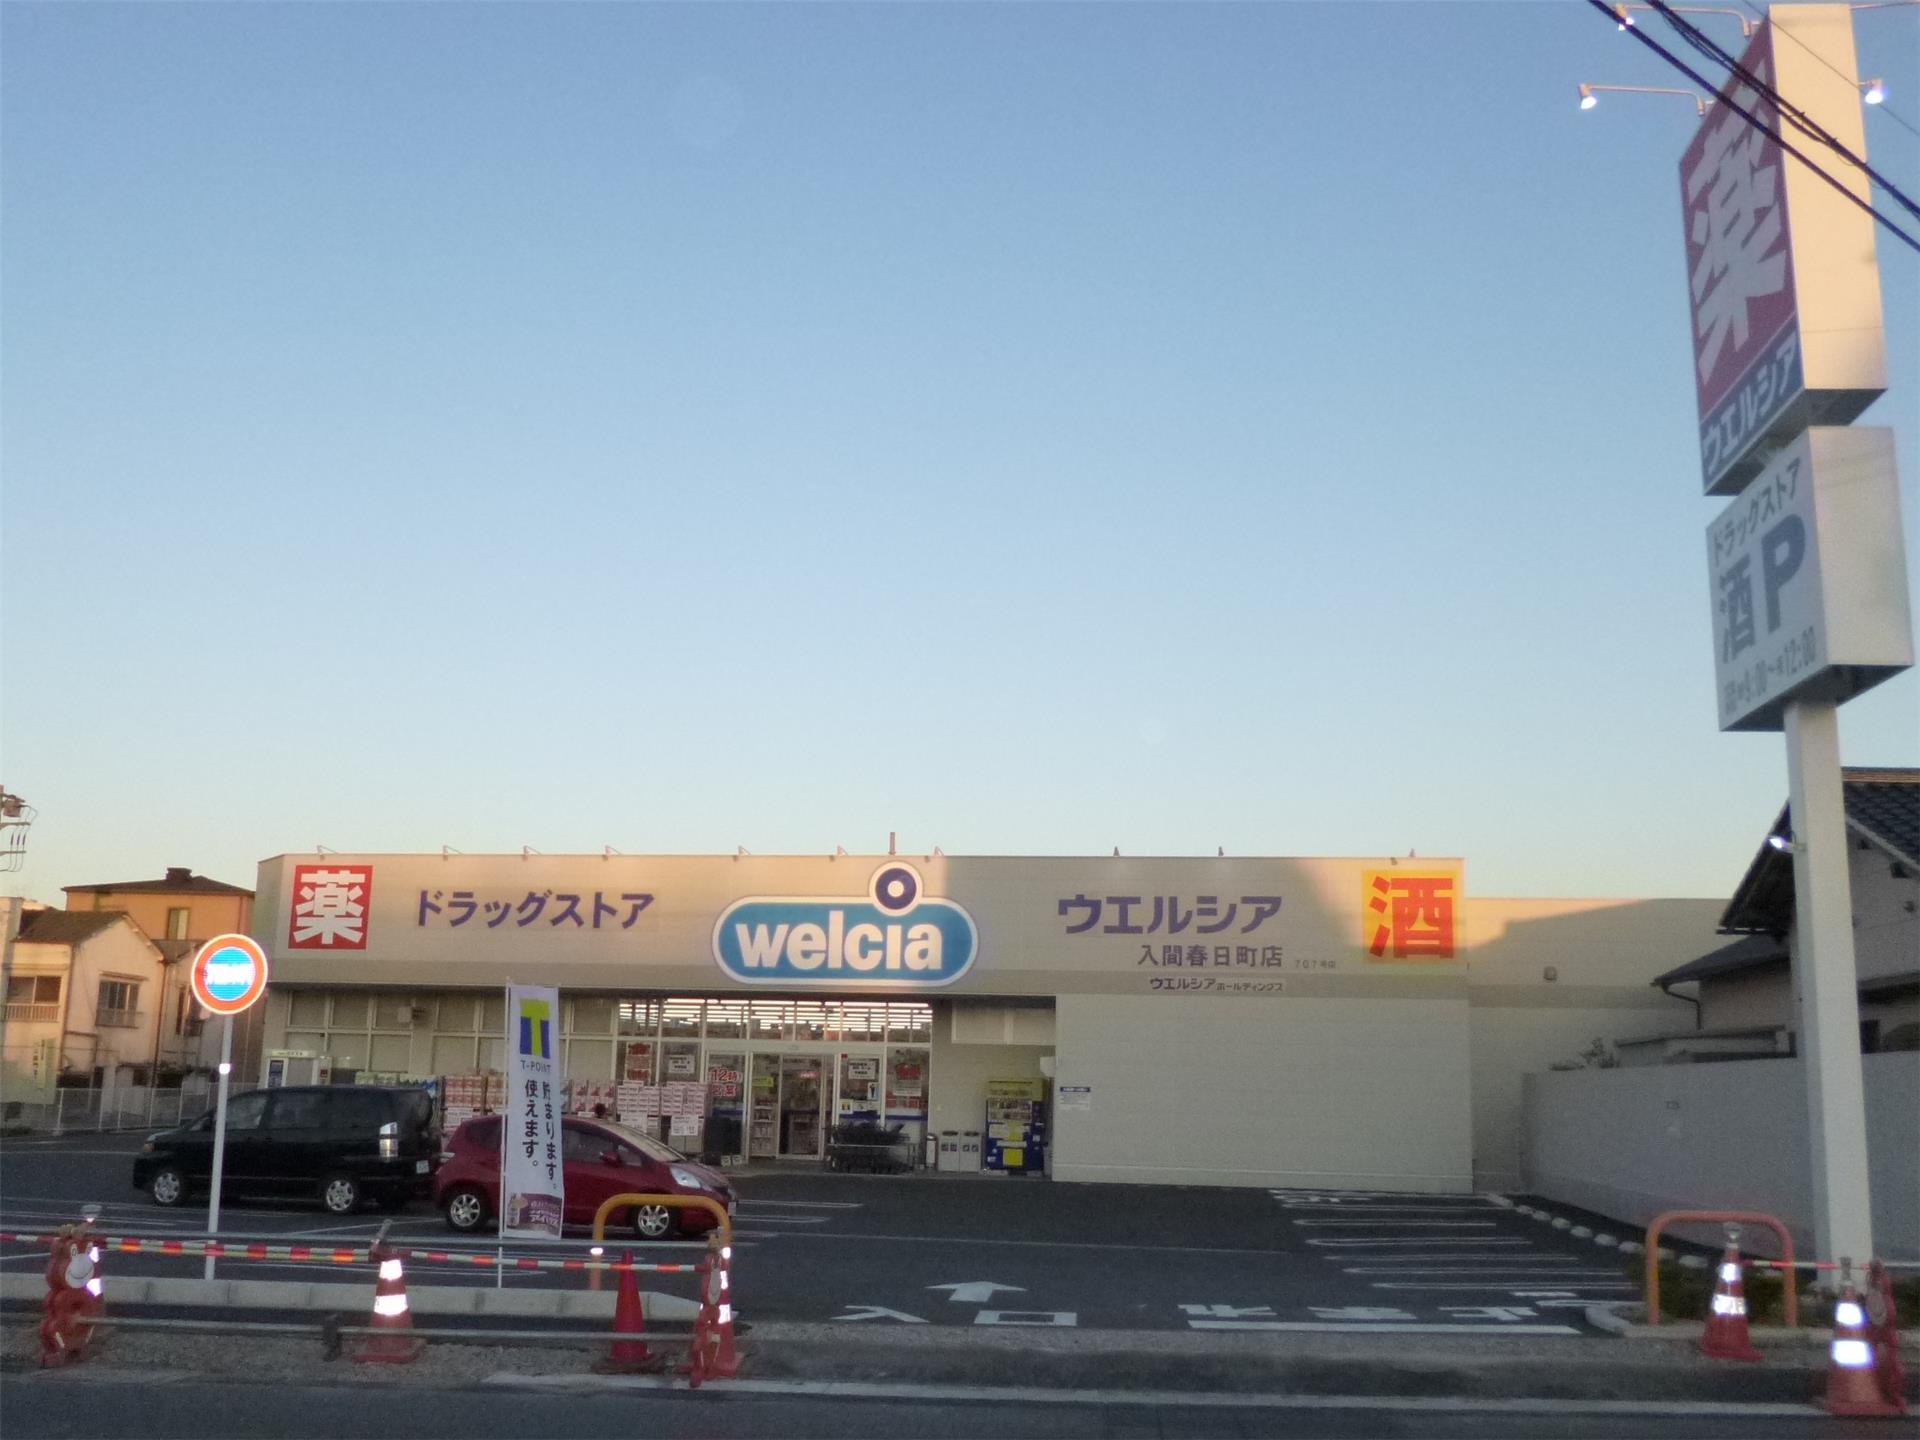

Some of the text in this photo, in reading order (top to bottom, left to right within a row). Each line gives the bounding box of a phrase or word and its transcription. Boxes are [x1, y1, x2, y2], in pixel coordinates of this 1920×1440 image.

[1687, 56, 1787, 384] 薬
[1702, 331, 1797, 475] ウエルシア
[1720, 513, 1806, 664] 酒 P
[293, 870, 366, 944] 薬
[418, 889, 655, 928] ドラッグストア
[735, 910, 943, 970] welcia
[1057, 894, 1282, 934] ウエルシア
[1368, 876, 1454, 958] 酒
[1138, 944, 1283, 968] 入間春日町店
[522, 1079, 539, 1168] 使えます。
[831, 1305, 1077, 1327] 入口
